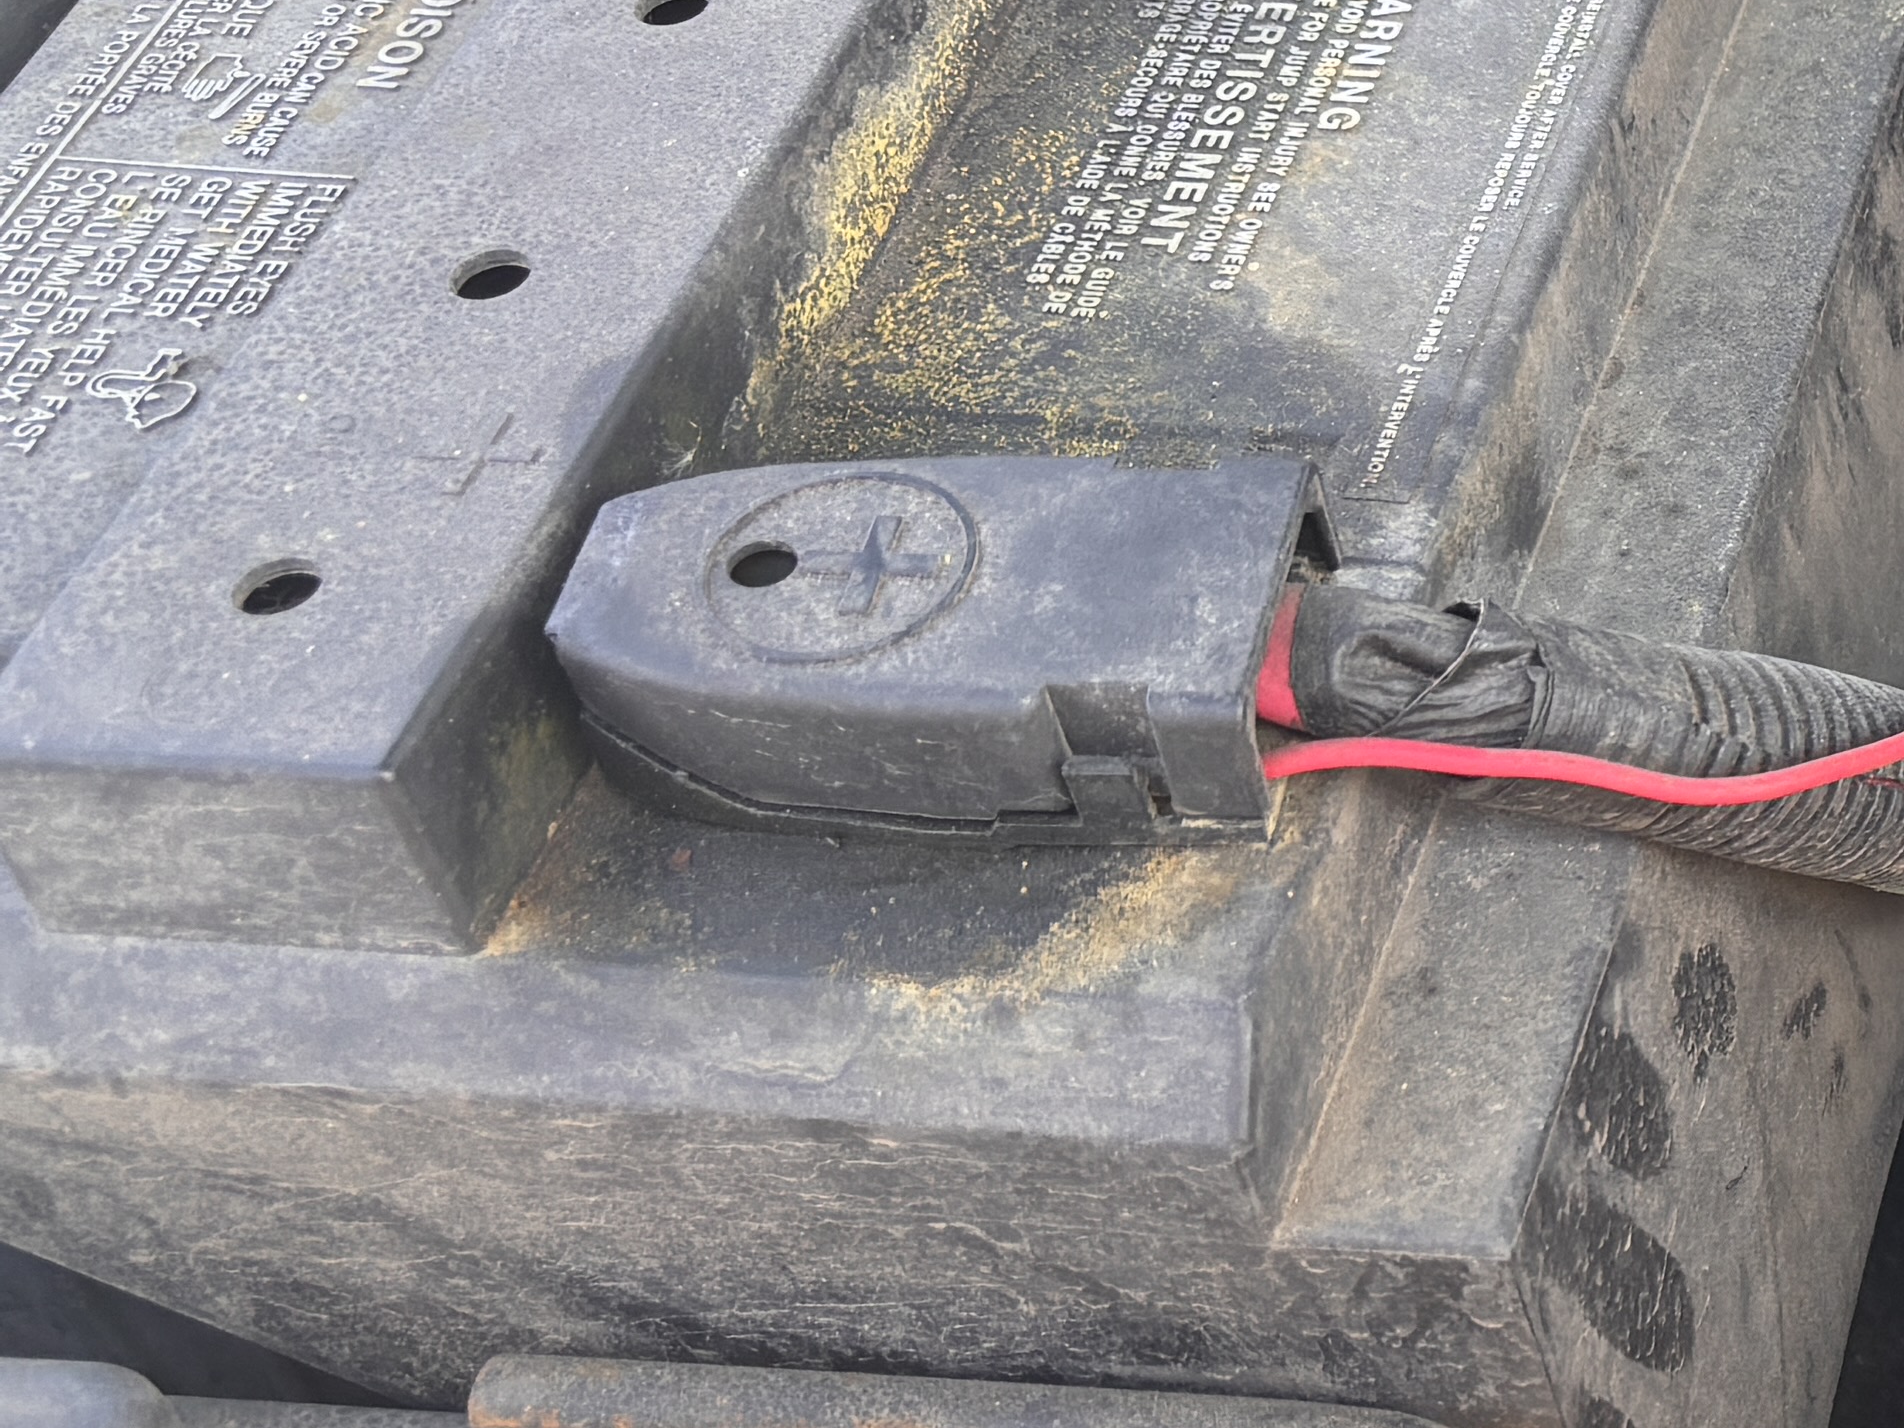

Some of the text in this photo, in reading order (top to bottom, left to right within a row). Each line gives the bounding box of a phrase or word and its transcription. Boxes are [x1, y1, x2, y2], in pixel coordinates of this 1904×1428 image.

[123, 3, 163, 24] LA
[185, 18, 220, 36] LA
[310, 4, 350, 26] OR
[1295, 11, 1331, 41] FOR
[64, 29, 144, 95] PORTÉE
[140, 42, 206, 93] CÉCITÉ
[261, 30, 329, 88] SEVERE
[308, 23, 372, 70] ACID
[1273, 45, 1313, 87] JUMP
[97, 53, 168, 113] GRAVES
[281, 72, 326, 102] CAN
[1292, 38, 1350, 115] PERSONAL
[31, 101, 84, 136] DES
[218, 92, 281, 144] BURNS
[1141, 91, 1176, 118] QUI
[1245, 91, 1291, 141] START
[238, 107, 301, 157] CAUSE
[1111, 123, 1159, 177] DONNE
[1263, 121, 1311, 176] INJURY
[1068, 2, 1256, 318] ÉVITER DES VOIR LE GUIDE
[1059, 194, 1092, 216] DE
[1096, 182, 1129, 202] LA
[1184, 146, 1263, 263] INSTRUCTIONS
[1245, 181, 1282, 212] SEE
[0, 168, 121, 296] CONSULTER
[139, 179, 272, 318] WITH WATER
[171, 181, 309, 328] IMMEDIATELY
[221, 183, 347, 315] FLUSH EYES
[1054, 208, 1119, 285] MÉTHODE
[1206, 217, 1264, 291] OWNER'S
[0, 174, 195, 402] SE RINCER LES YEUX
[1431, 235, 1481, 314] COUVERCLE
[12, 177, 237, 454] GET MEDICAL HELP FAST
[1040, 290, 1073, 313] DE
